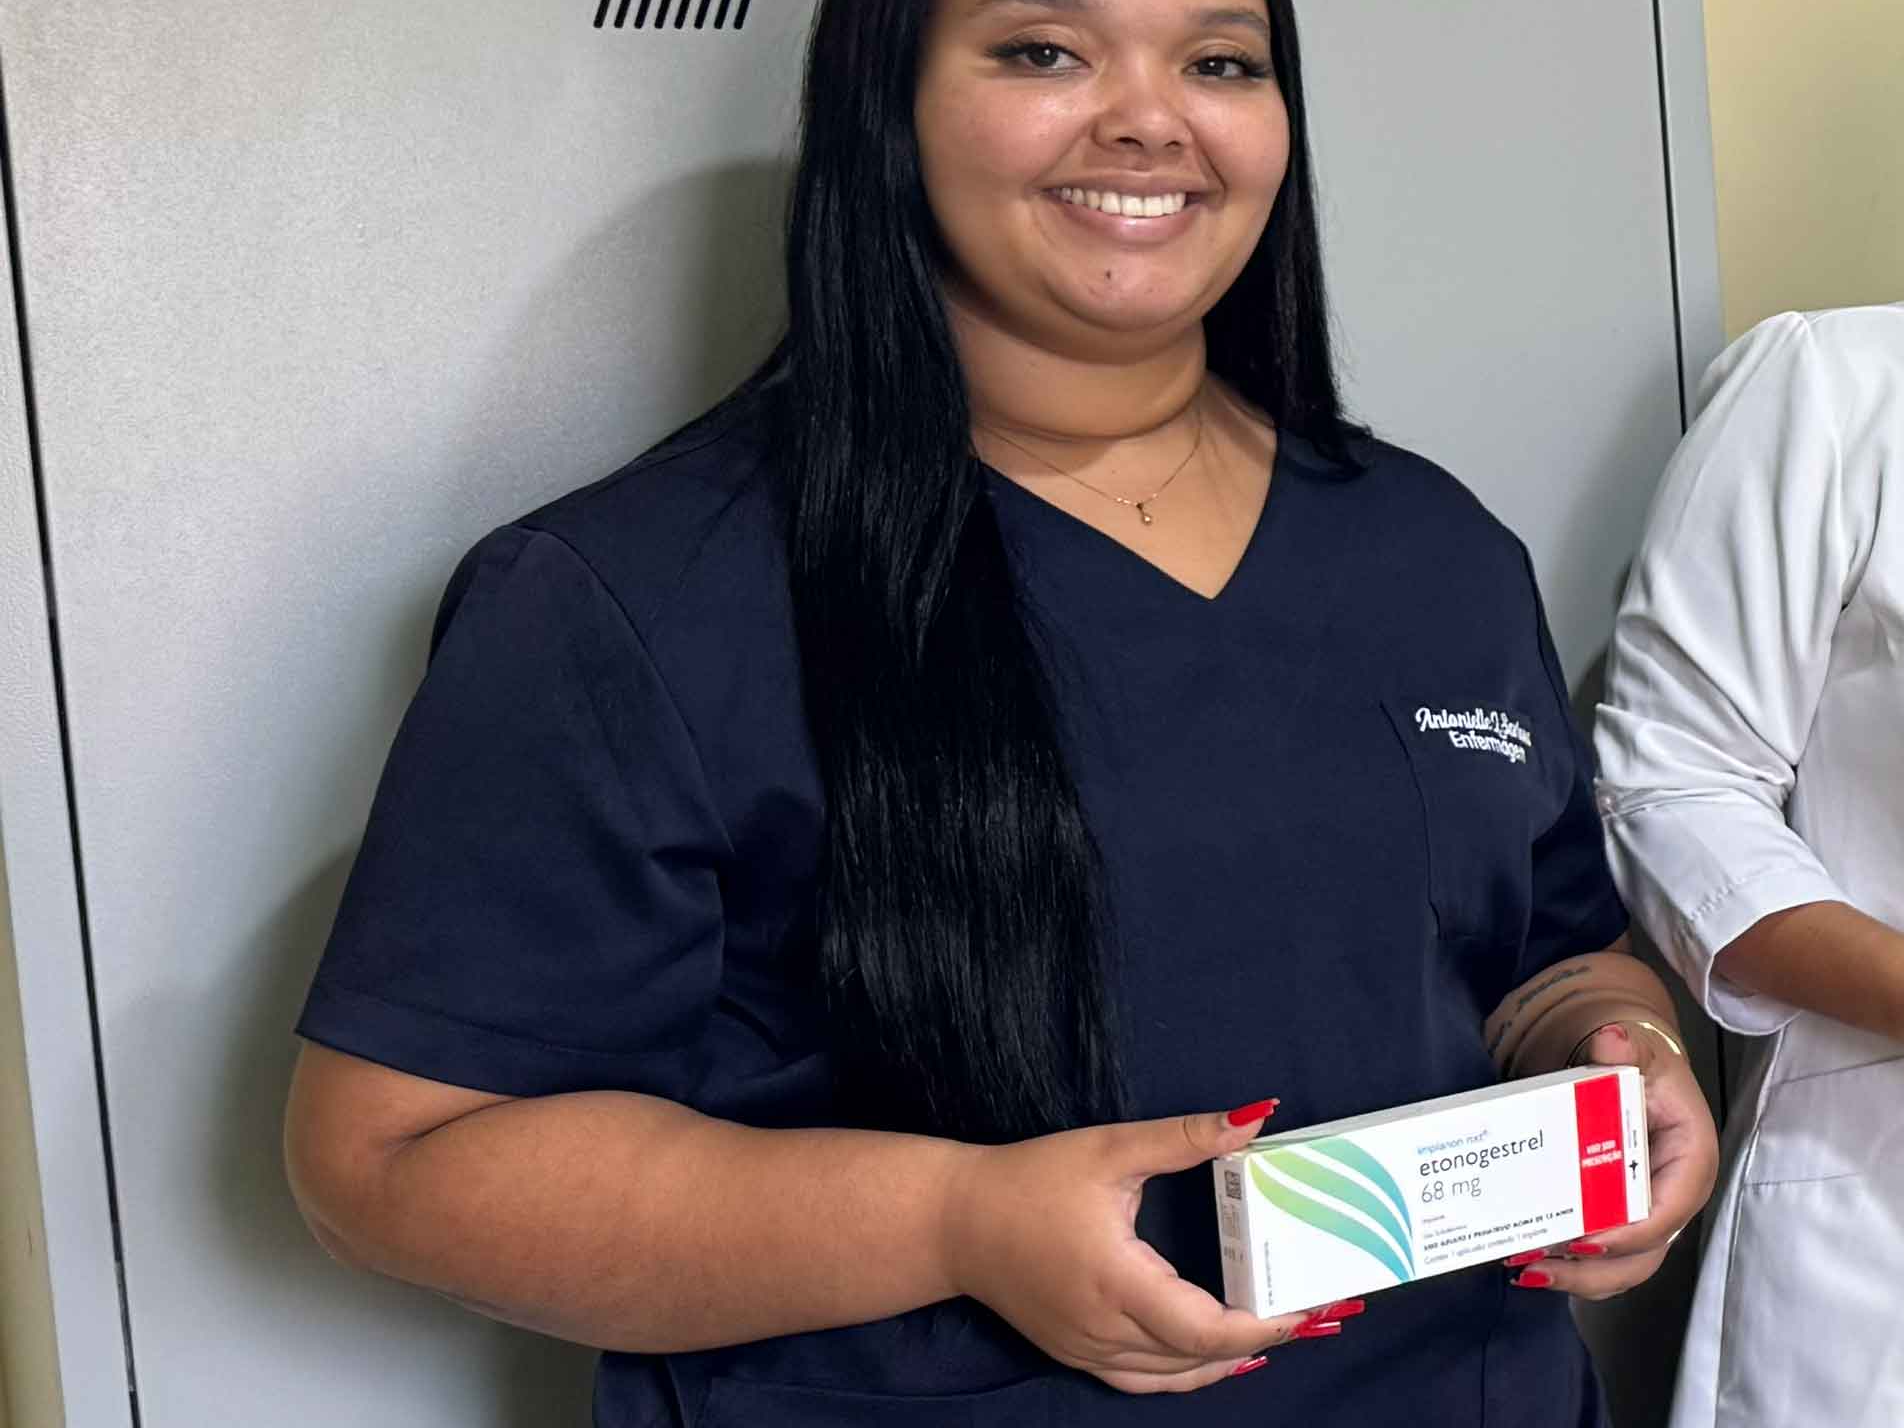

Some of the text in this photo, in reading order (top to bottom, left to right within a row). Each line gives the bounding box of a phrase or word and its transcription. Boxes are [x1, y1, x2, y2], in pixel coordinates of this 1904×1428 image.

[1420, 1129, 1544, 1176] etonogestrel
[1421, 1177, 1482, 1203] 68 mg
